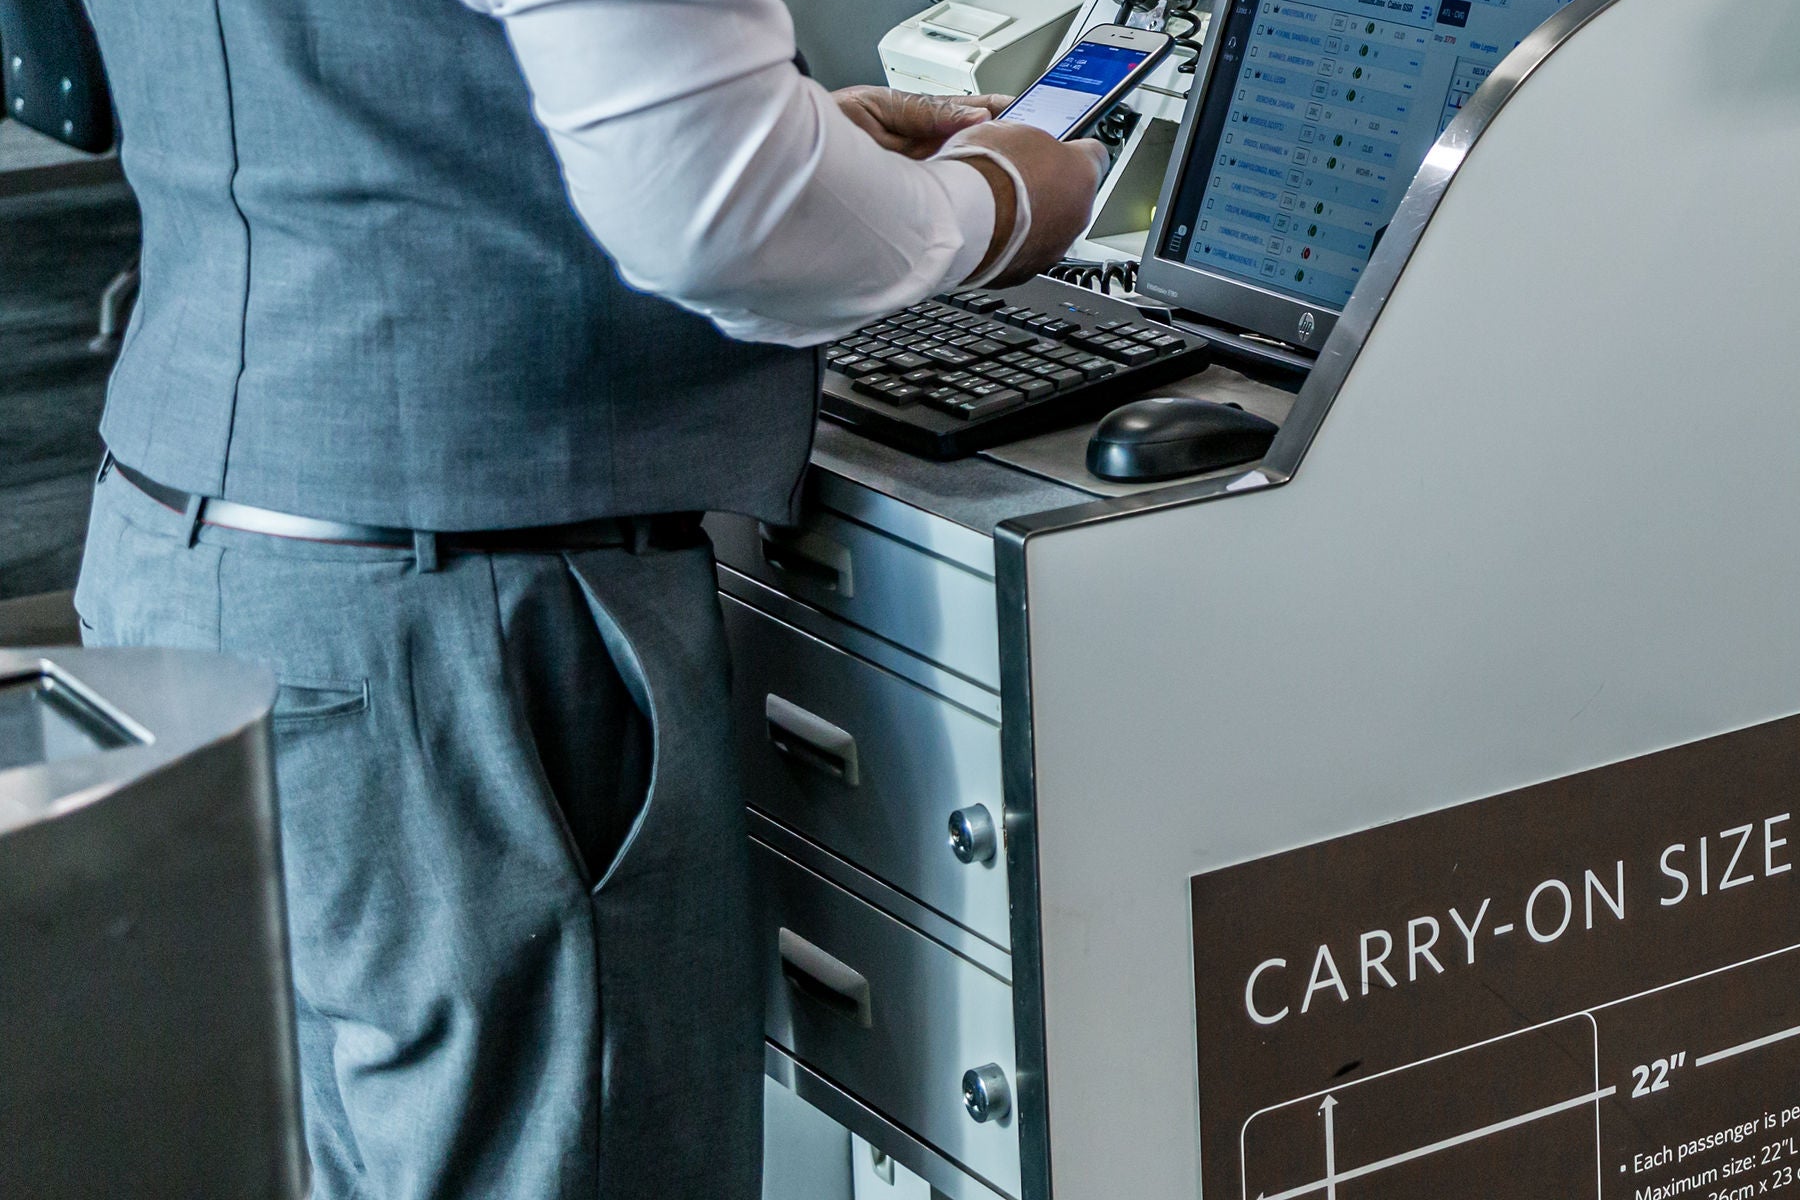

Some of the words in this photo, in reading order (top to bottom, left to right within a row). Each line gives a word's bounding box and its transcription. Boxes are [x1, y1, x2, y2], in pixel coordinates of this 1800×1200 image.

[1244, 860, 1626, 1026] CARRY-ON
[1659, 813, 1794, 907] SIZE
[1631, 1051, 1687, 1099] 22"
[1633, 1145, 1673, 1174] Each
[1677, 1118, 1760, 1164] passenger
[1764, 1111, 1777, 1129] is
[1635, 1167, 1718, 1200] Maximum
[1722, 1155, 1757, 1179] size:
[1761, 1138, 1798, 1166] 22"L
[1759, 1179, 1768, 1194] x
[1772, 1166, 1792, 1190] 23
